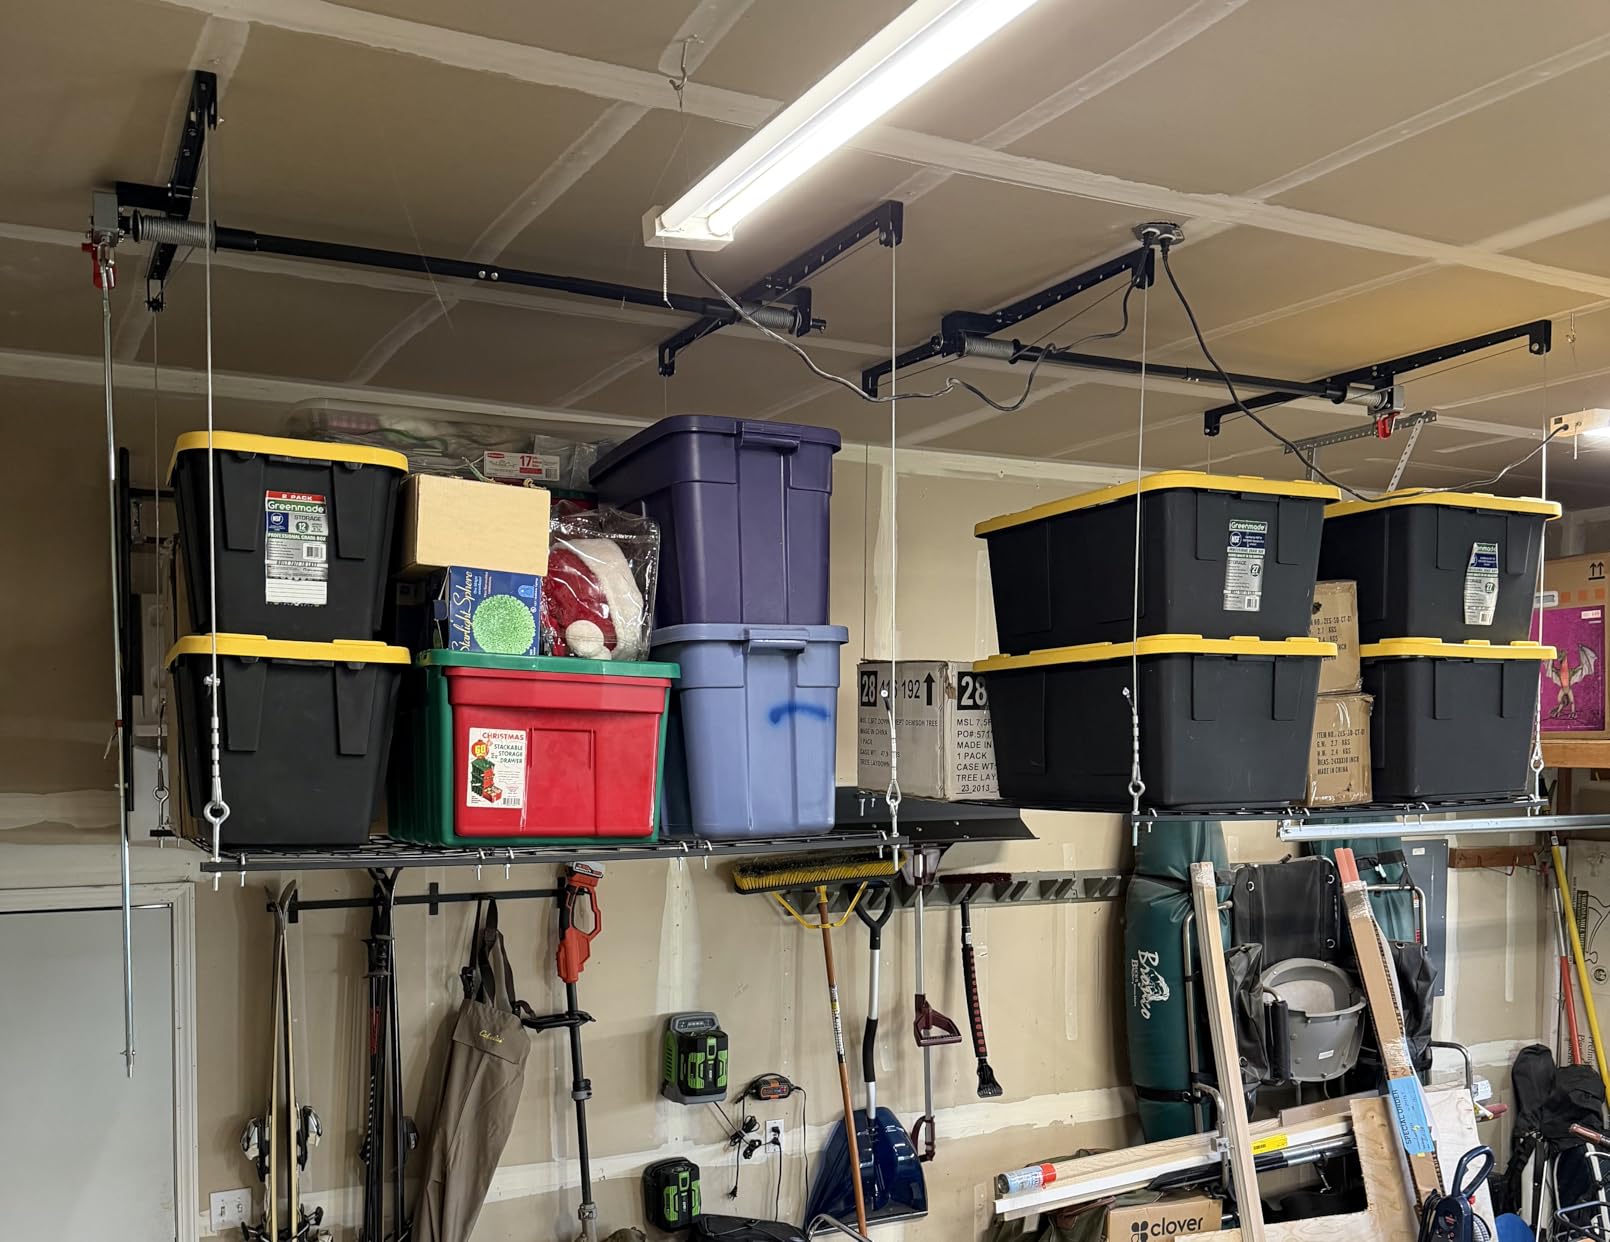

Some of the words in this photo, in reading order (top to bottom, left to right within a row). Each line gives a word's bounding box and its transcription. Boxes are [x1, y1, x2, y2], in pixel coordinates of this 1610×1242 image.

[520, 455, 532, 467] 17
[268, 500, 325, 513] Greenmade
[298, 522, 307, 530] 12
[1231, 521, 1266, 531] Greenmade
[453, 571, 475, 610] Sphere
[861, 674, 877, 703] 28
[901, 679, 921, 699] 192
[960, 674, 989, 706] 28
[957, 718, 974, 727] MSL
[482, 732, 525, 741] CHRISTMAS
[957, 730, 993, 739] PO#:571
[494, 743, 523, 751] STACKABLE
[957, 741, 982, 750] MADE
[984, 741, 993, 749] IN
[498, 750, 523, 758] STORAGE
[964, 752, 988, 760] PACK
[956, 763, 979, 771] CASE
[1317, 767, 1329, 775] MADE
[1335, 765, 1349, 774] CHINA
[956, 774, 979, 783] TREE
[1391, 1088, 1405, 1115] ORDER
[1399, 1114, 1413, 1145] SPECIAL
[1150, 1216, 1204, 1237] clover
